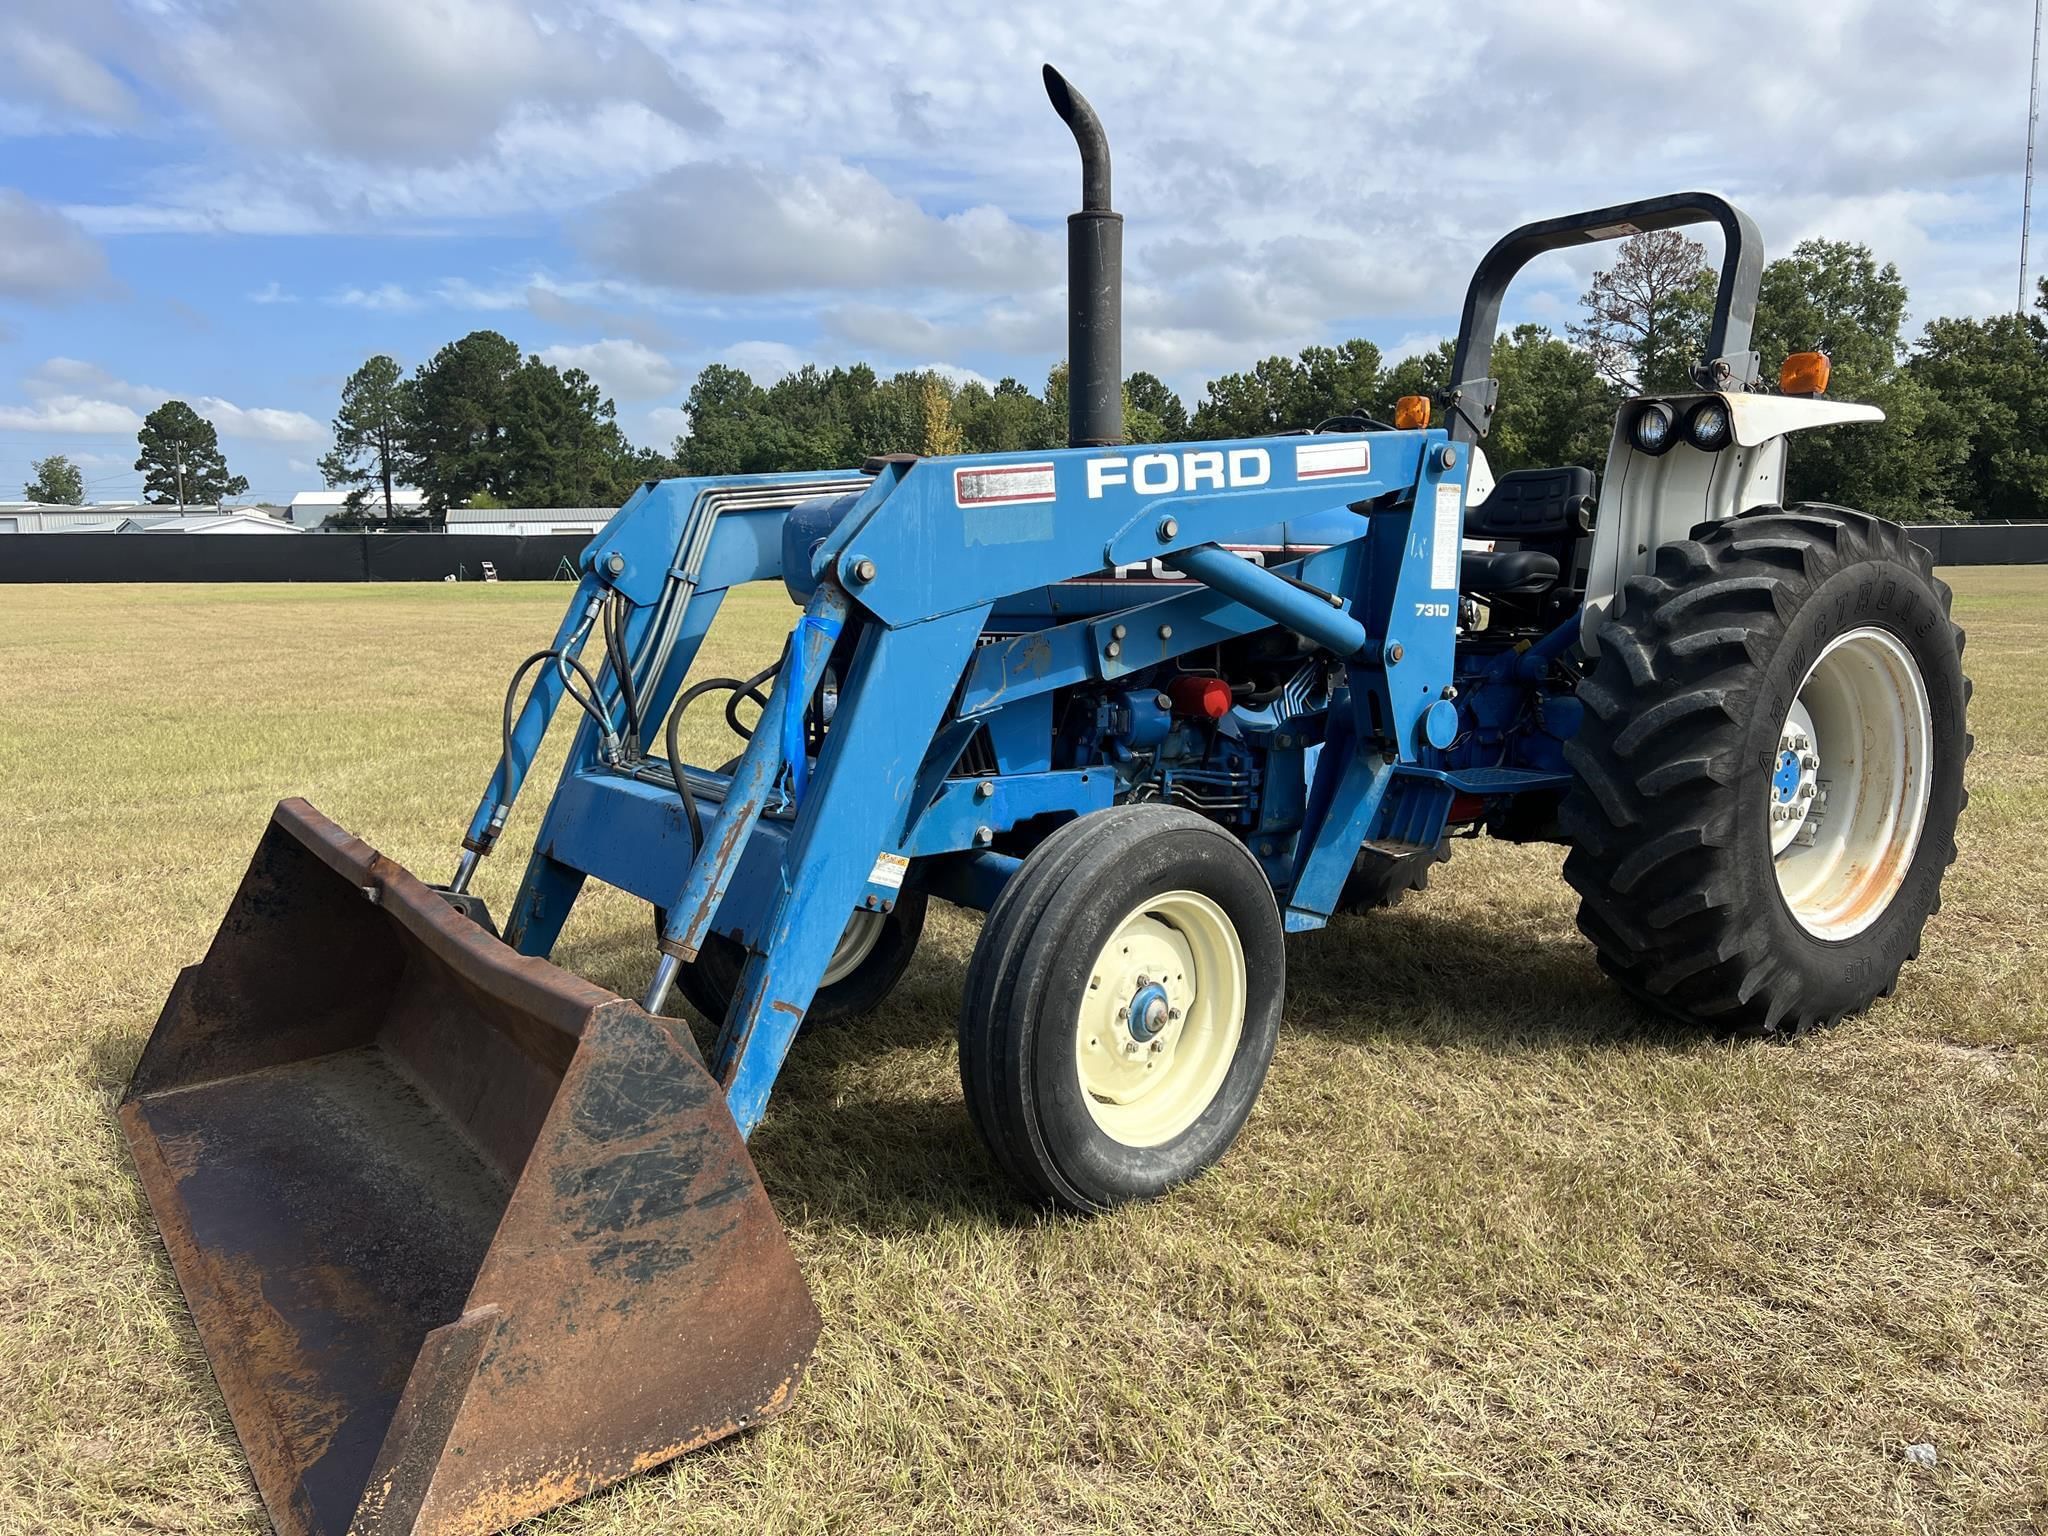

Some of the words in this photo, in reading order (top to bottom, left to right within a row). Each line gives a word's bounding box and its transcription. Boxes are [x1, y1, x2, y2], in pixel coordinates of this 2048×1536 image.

[1086, 448, 1271, 499] FORD
[1415, 603, 1450, 617] 7310
[1844, 956, 1873, 984] LUG
